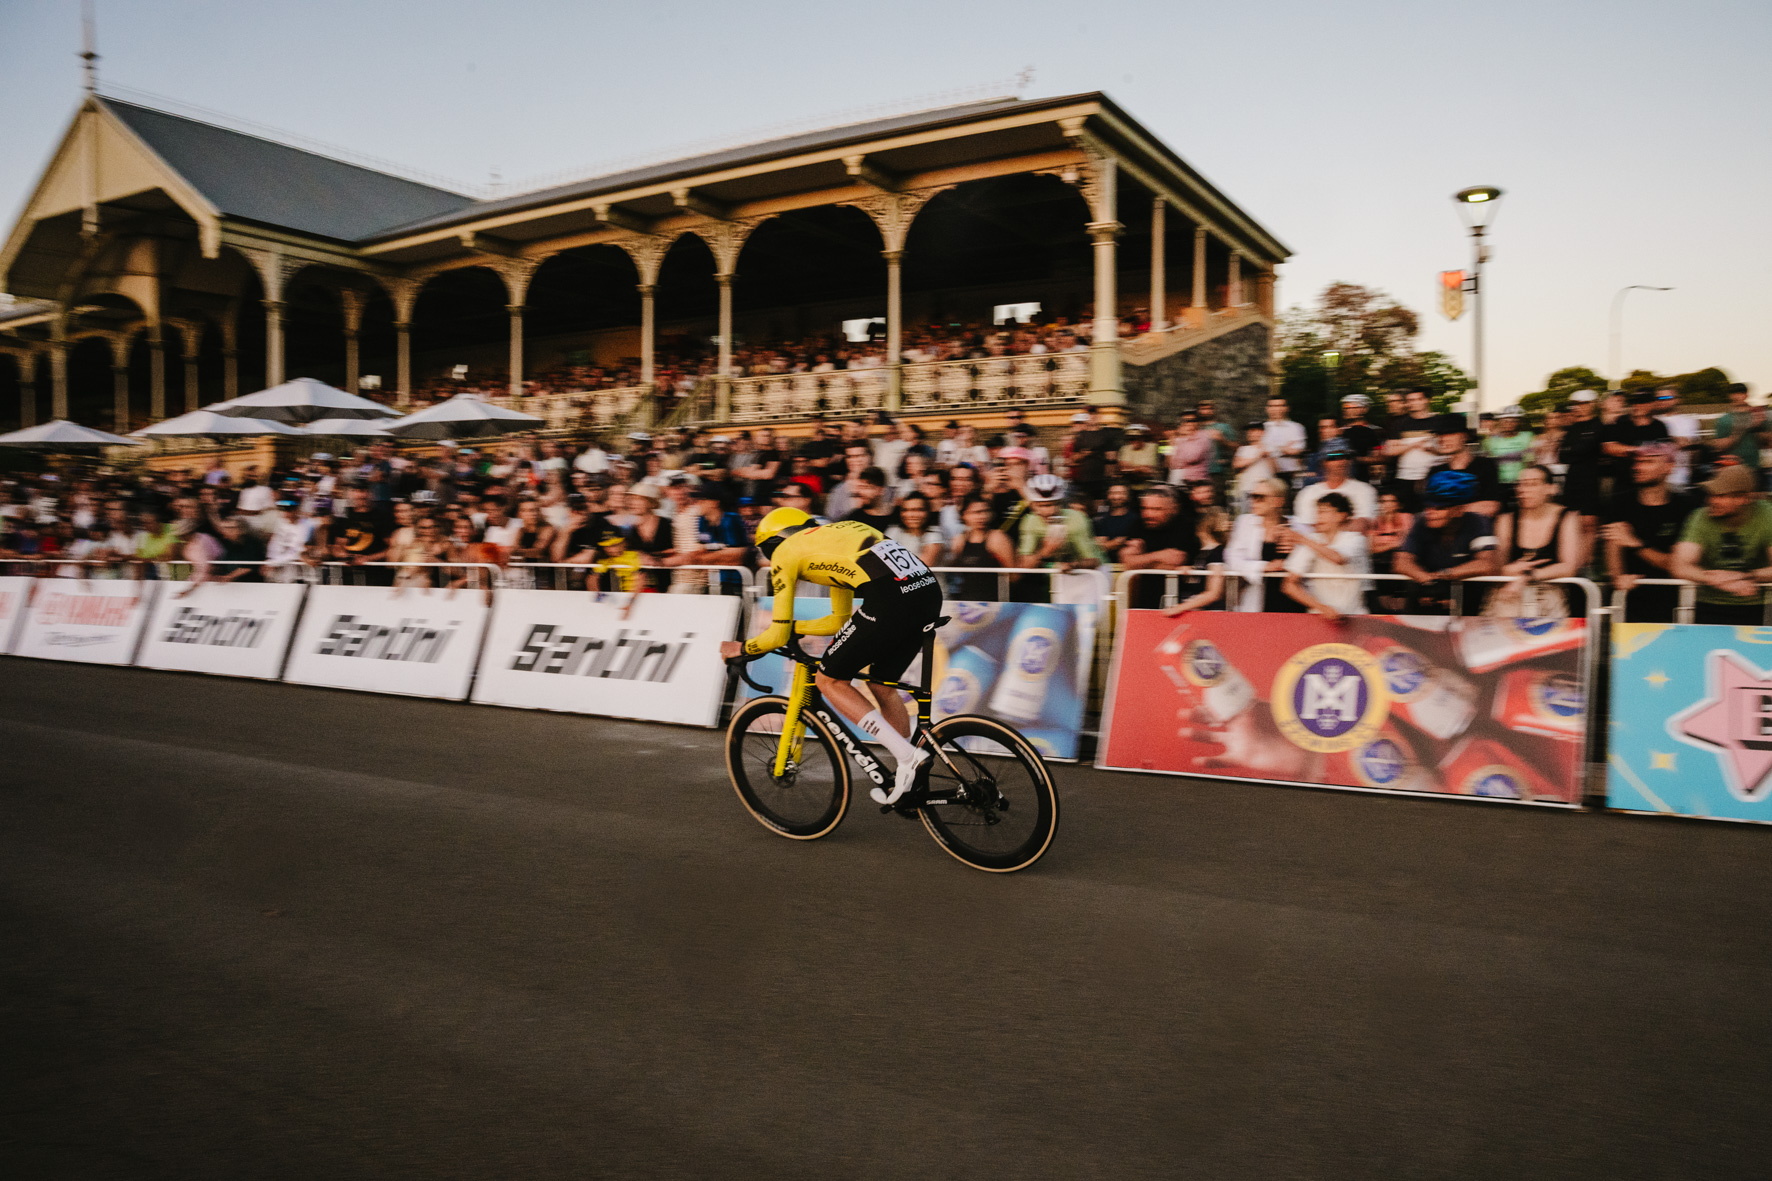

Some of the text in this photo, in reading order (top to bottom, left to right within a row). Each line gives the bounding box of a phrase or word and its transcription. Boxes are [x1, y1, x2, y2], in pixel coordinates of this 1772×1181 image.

[807, 561, 857, 579] Rabobank
[883, 548, 918, 572] 157
[313, 614, 463, 664] Santini
[508, 623, 699, 684] Santini
[816, 710, 884, 784] cervélo
